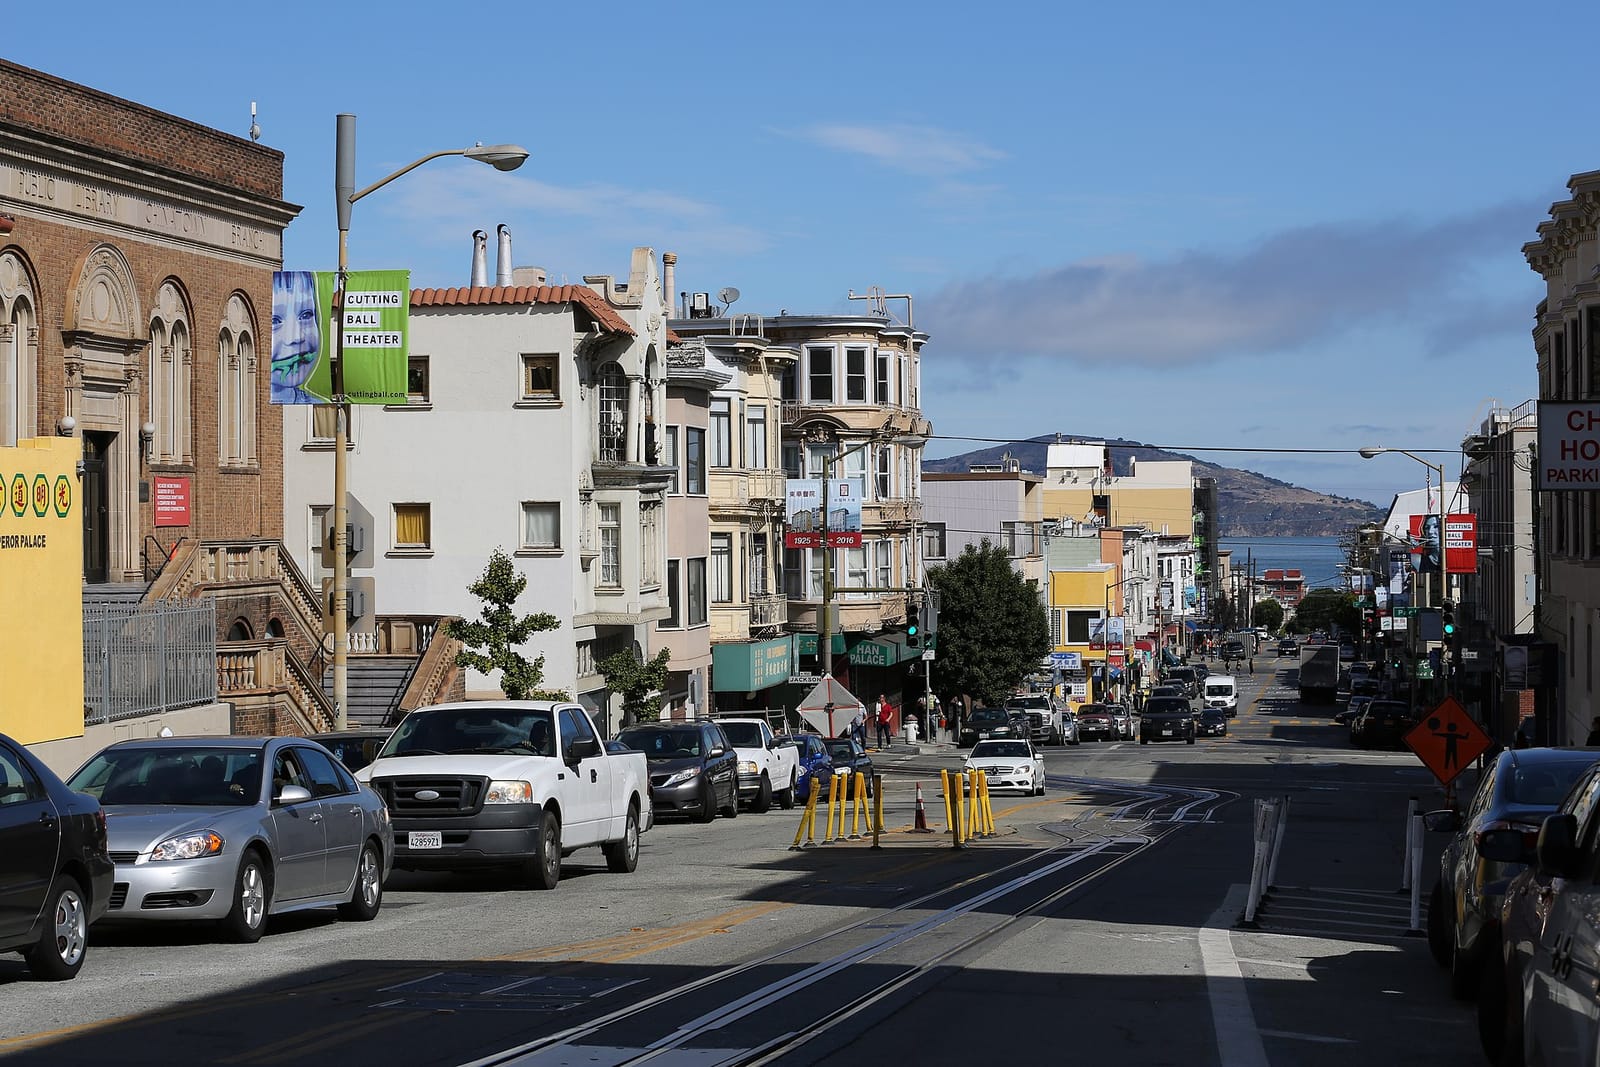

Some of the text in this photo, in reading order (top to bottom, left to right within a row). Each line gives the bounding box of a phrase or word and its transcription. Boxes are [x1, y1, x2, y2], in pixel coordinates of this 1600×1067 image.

[19, 170, 55, 200] PUBLIC
[76, 183, 119, 216] LIBRARY
[347, 294, 399, 304] CUTTING
[347, 315, 377, 324] BALL
[346, 335, 399, 344] THEATER
[348, 391, 405, 399] cuttingball.com
[20, 534, 46, 548] PALACE
[836, 536, 854, 544] 2016
[856, 645, 880, 655] HAN
[849, 655, 885, 665] PALACE
